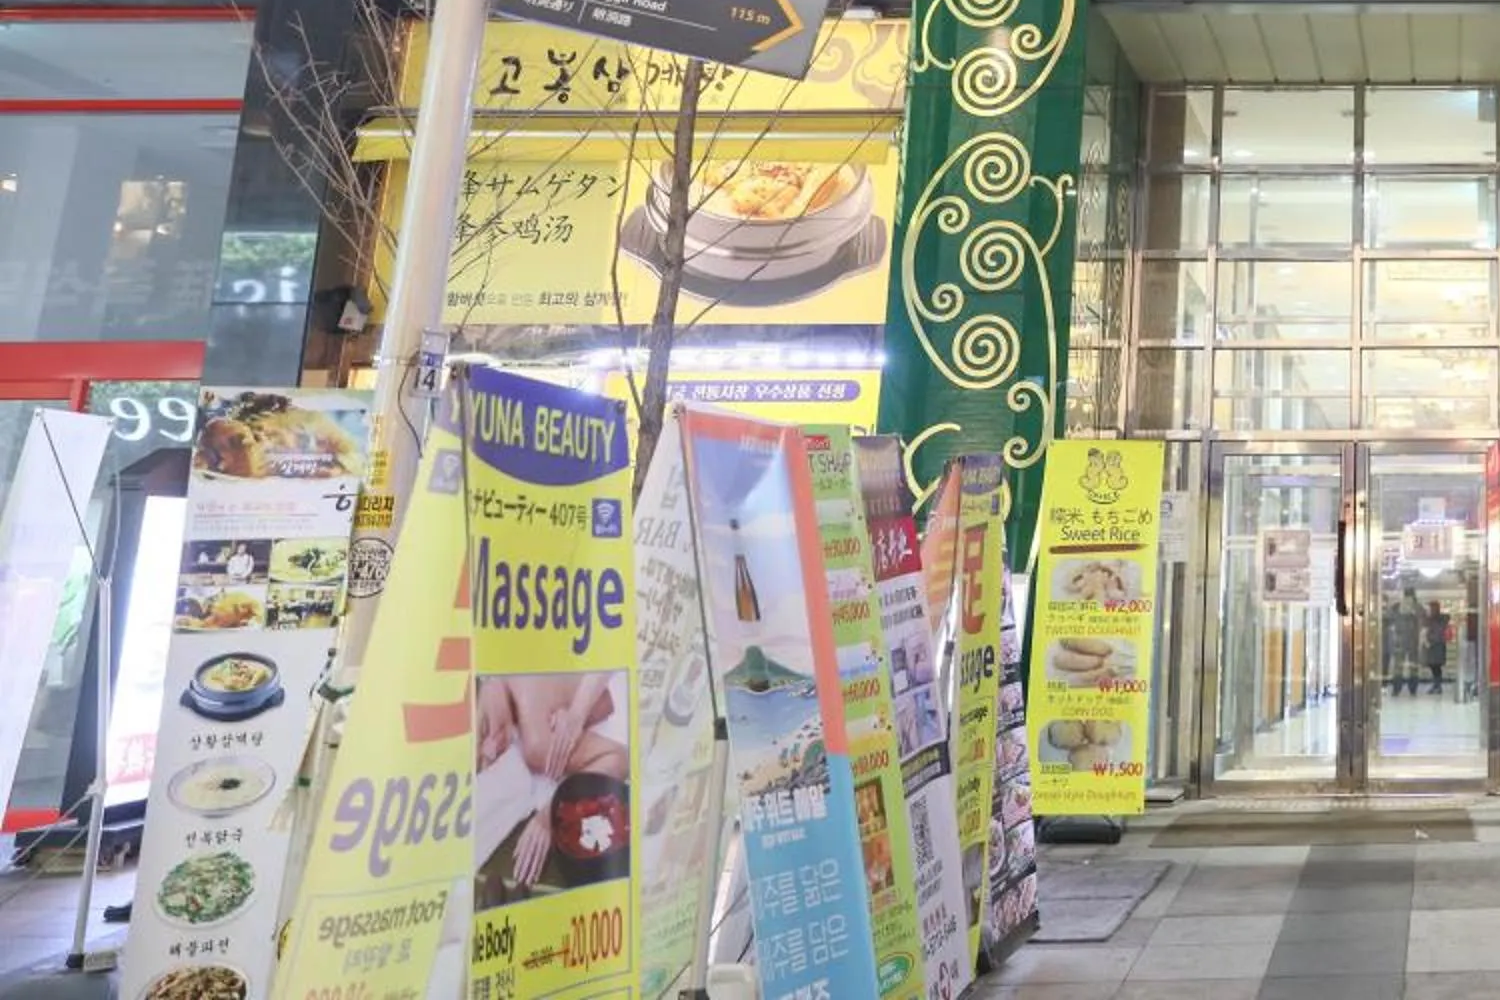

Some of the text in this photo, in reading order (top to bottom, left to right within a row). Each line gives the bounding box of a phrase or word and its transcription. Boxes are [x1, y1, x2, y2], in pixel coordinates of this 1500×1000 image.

[730, 6, 771, 25] 115 m
[470, 390, 617, 464] YUNA BEAUTY
[470, 488, 547, 525] ナビューティー
[1092, 508, 1153, 526] もちごめ
[1060, 525, 1141, 542] Sweet Rice
